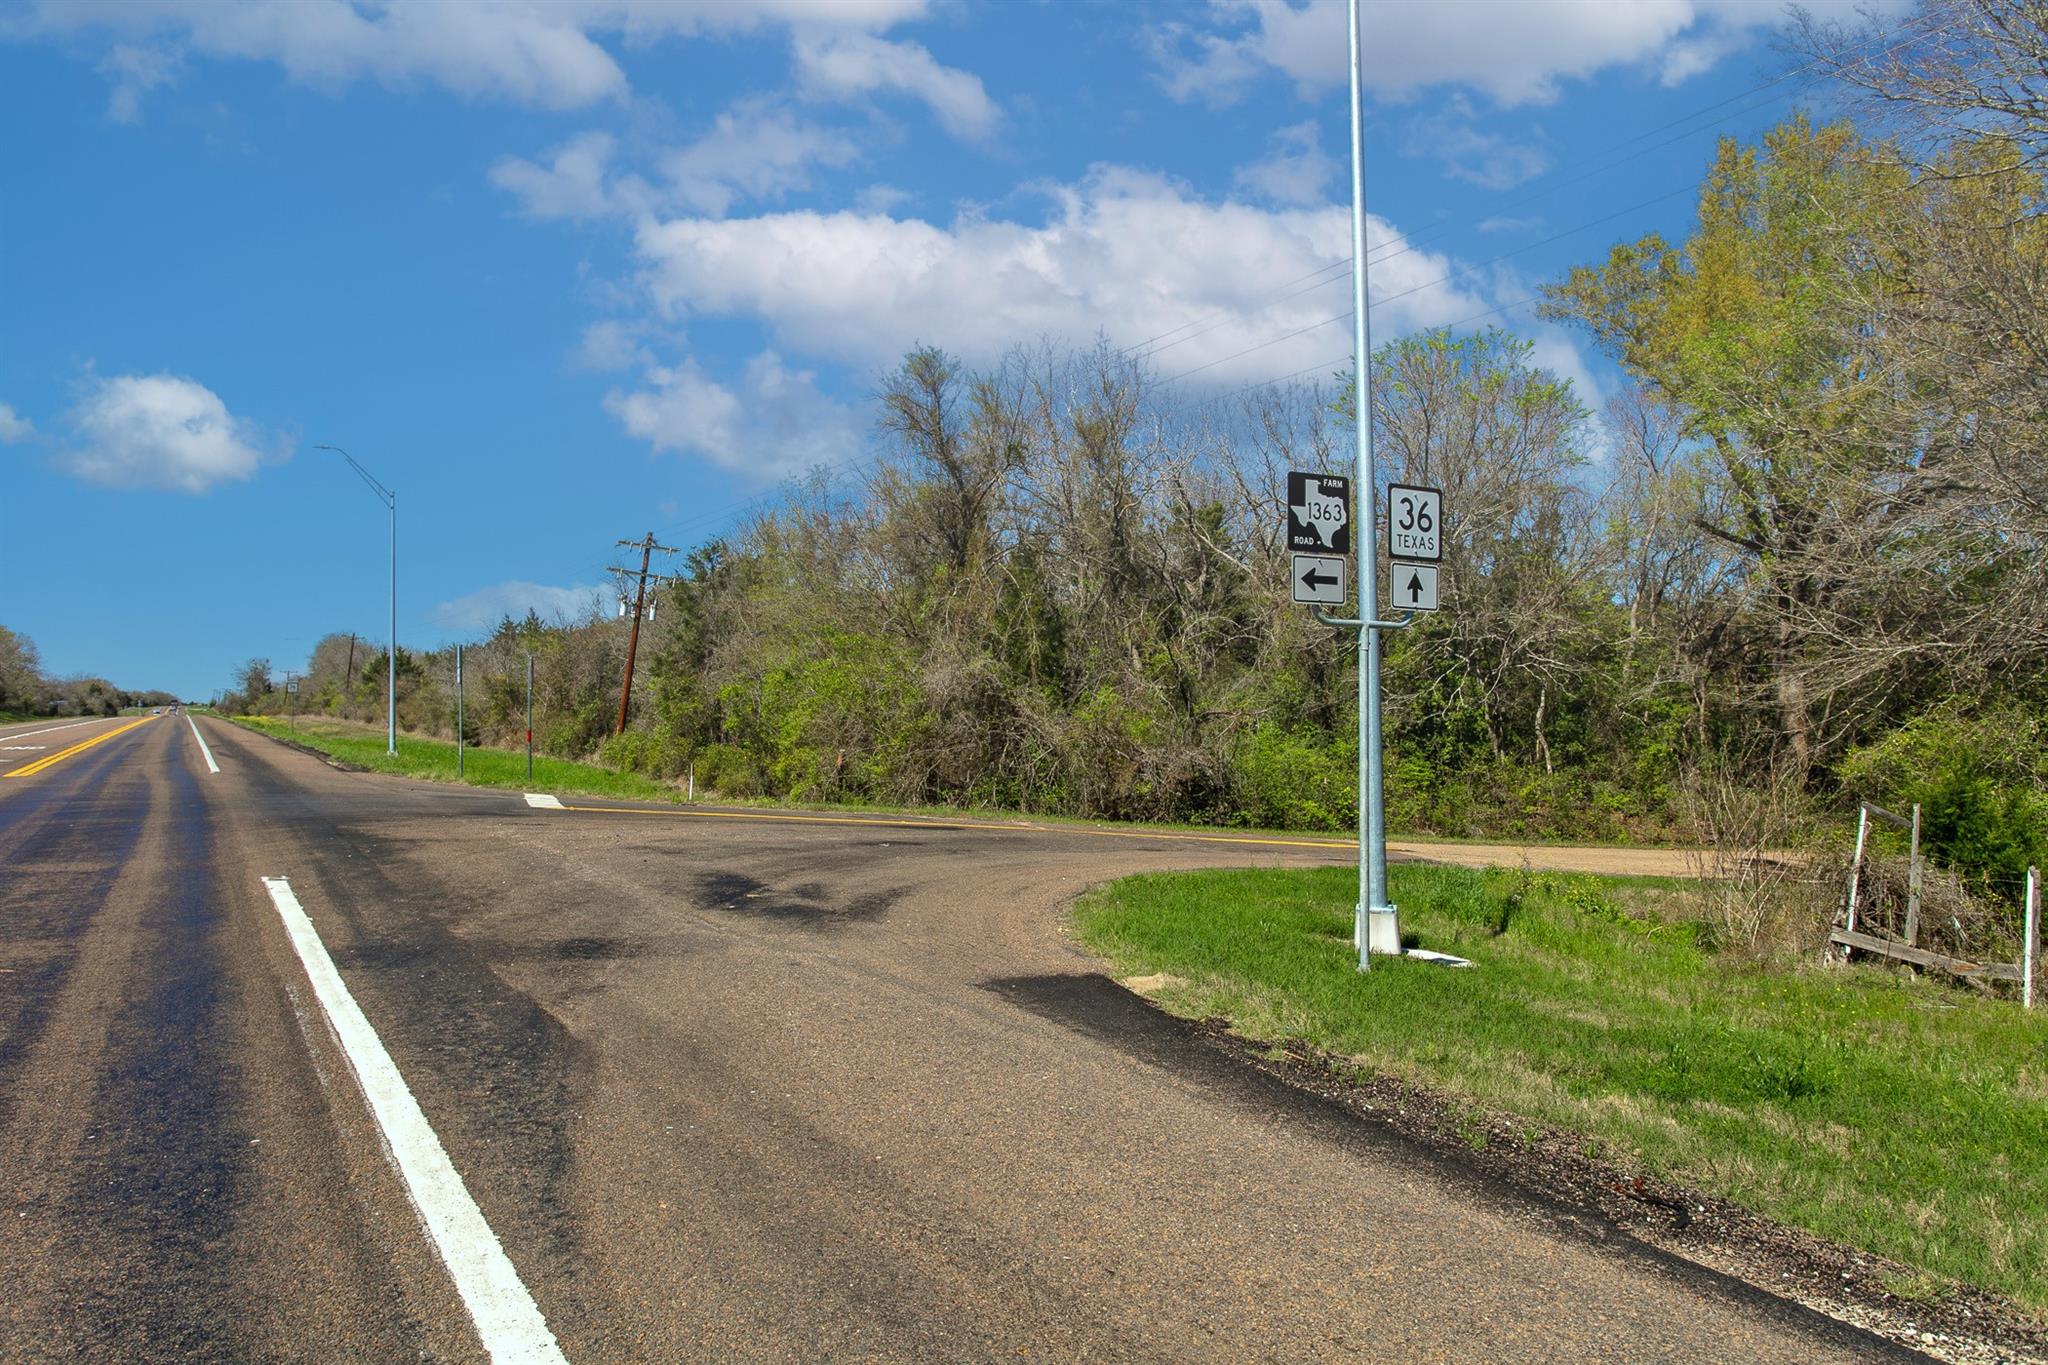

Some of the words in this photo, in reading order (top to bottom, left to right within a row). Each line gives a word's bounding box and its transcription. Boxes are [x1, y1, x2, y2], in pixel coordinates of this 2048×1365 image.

[1323, 479, 1343, 488] FARM
[1308, 502, 1342, 522] 1363
[1399, 497, 1433, 533] 36
[1294, 535, 1314, 545] ROAD
[1397, 534, 1435, 551] TEXAS
